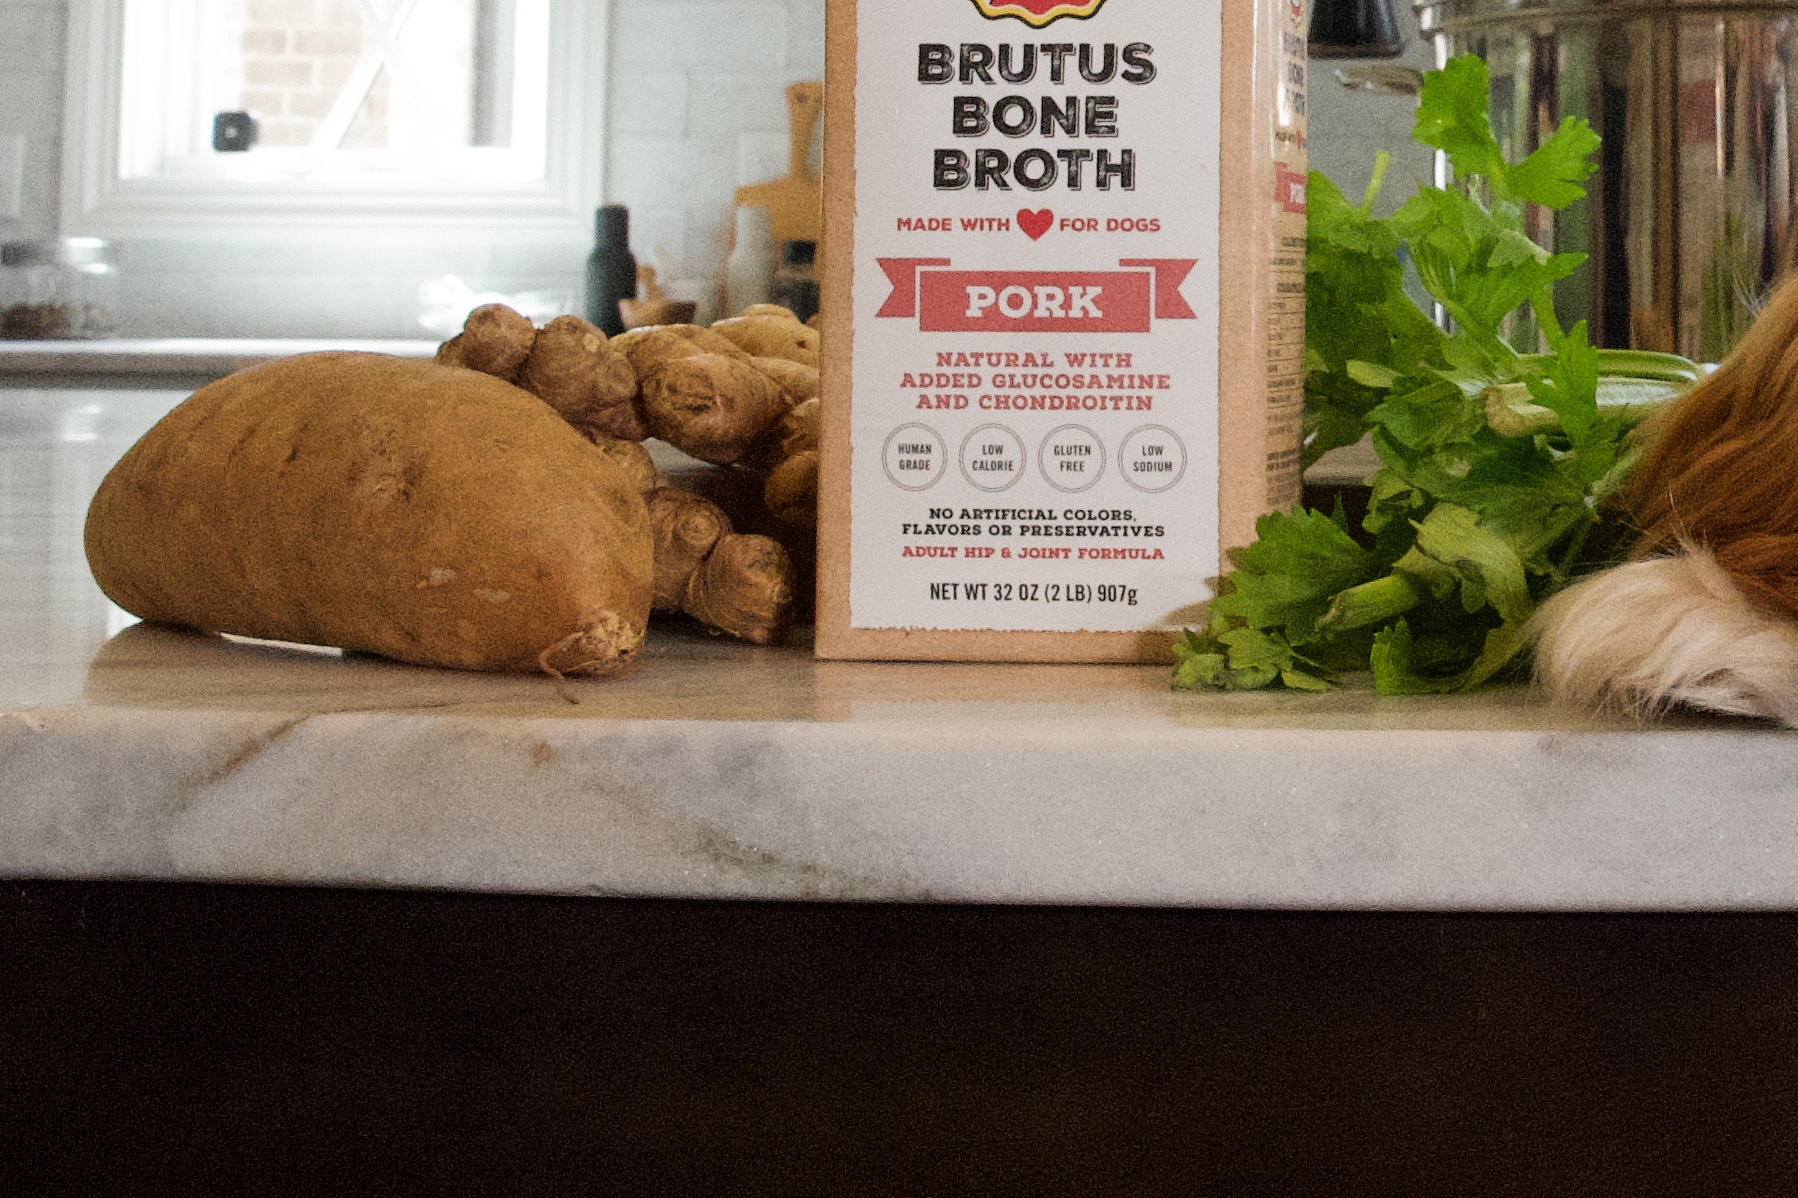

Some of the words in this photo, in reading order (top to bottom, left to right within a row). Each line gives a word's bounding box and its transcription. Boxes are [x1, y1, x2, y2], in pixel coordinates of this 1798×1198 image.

[917, 42, 1156, 84] BRUTUS
[952, 95, 1118, 137] BONE
[934, 148, 1136, 191] BROTH
[897, 217, 952, 232] MADE
[960, 217, 1010, 232] WITH
[1059, 218, 1099, 232] FOR
[1106, 218, 1160, 232] DOGS
[965, 285, 1103, 318] PORK
[936, 352, 1054, 368] NATURAL
[1064, 352, 1133, 368] WITH
[900, 373, 982, 389] ADDED
[991, 373, 1171, 390] GLUCOSAMINE
[916, 395, 968, 410] AND
[978, 395, 1153, 411] CHONDROITIN
[898, 443, 932, 456] HUMAN
[982, 443, 1003, 456] LOW
[1053, 444, 1091, 456] GLUTEN
[1142, 445, 1163, 456] LOW
[899, 459, 931, 471] GRADE
[972, 459, 1014, 472] CALORIE
[1060, 460, 1085, 472] FREE
[1133, 460, 1172, 473] SODIUM
[929, 508, 954, 520] NO
[959, 508, 1057, 521] ARTIFICIAL
[1063, 509, 1137, 523] COLORS,
[902, 524, 982, 536] FLAVORS
[988, 524, 1012, 536] OR
[1019, 524, 1165, 538] PRESERVATIVES
[902, 546, 958, 558] ADULT
[963, 546, 996, 559] HIP
[1001, 546, 1012, 559] &
[1018, 547, 1071, 560] JOINT
[1077, 547, 1165, 560] FORMULA
[930, 583, 959, 601] NET
[963, 583, 988, 601] WT
[993, 584, 1013, 602] 32
[1018, 584, 1039, 602] OZ
[1044, 584, 1060, 603] (2
[1065, 584, 1092, 603] LB)
[1097, 585, 1138, 606] 907g
